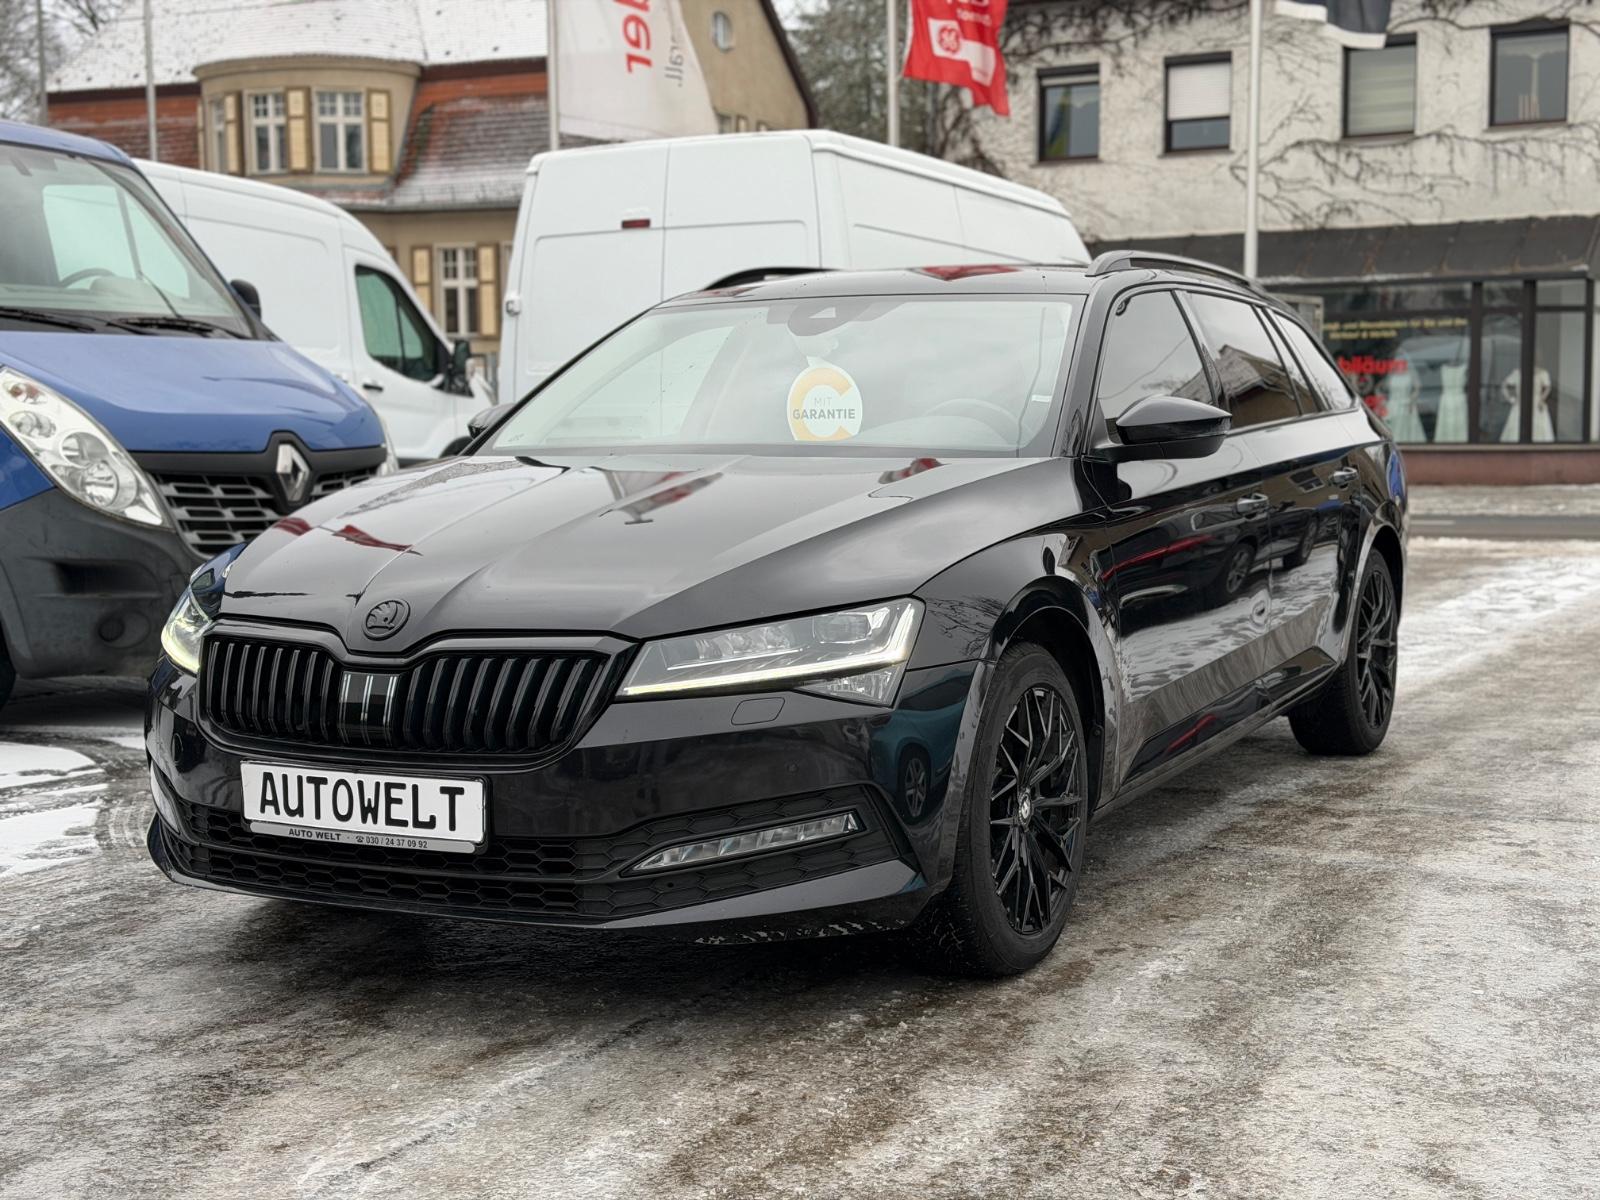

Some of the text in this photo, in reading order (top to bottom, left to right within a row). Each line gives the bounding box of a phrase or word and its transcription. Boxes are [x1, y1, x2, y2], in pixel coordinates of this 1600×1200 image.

[814, 397, 832, 406] MIT
[792, 409, 855, 420] GARANTIE
[259, 771, 465, 832] AUTOWELT
[289, 828, 313, 839] AUTO
[316, 830, 341, 841] WELT
[366, 836, 379, 845] 030
[386, 838, 395, 846] 24
[396, 838, 405, 847] 37
[408, 839, 417, 848] 09
[418, 840, 428, 849] 92
